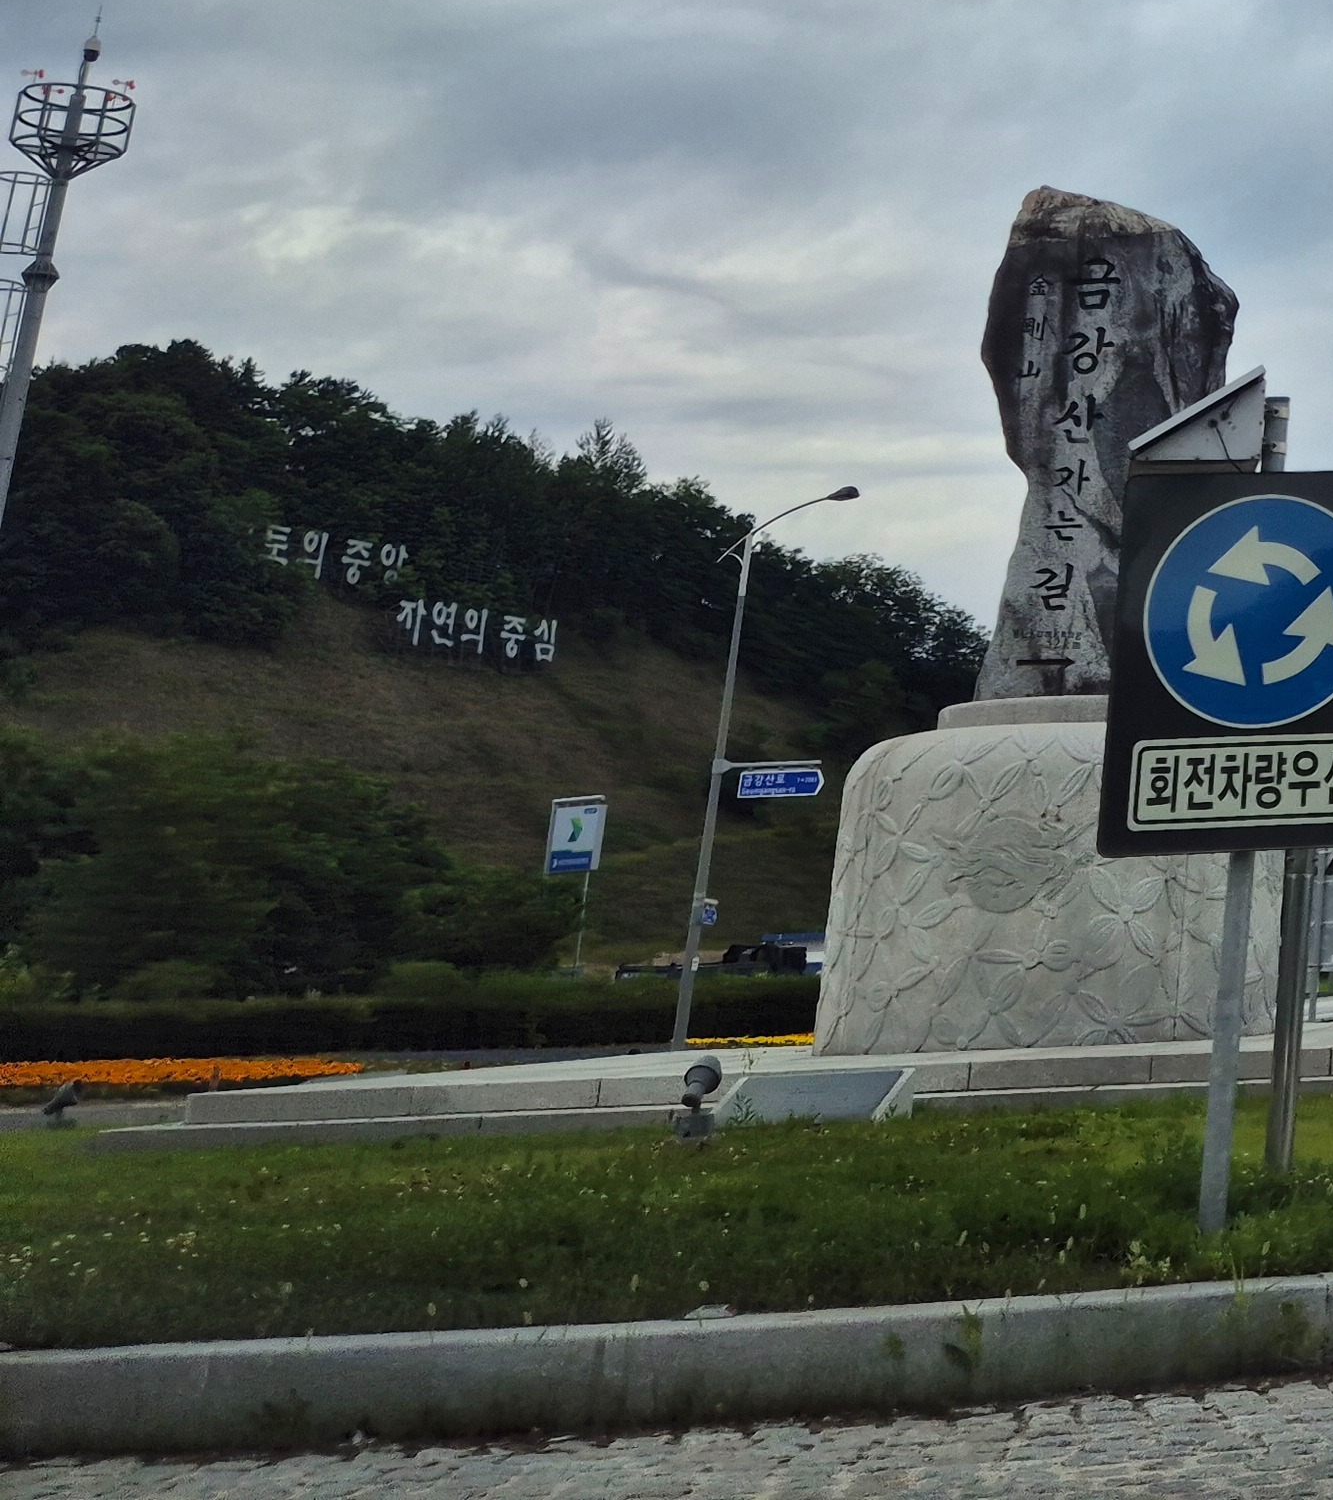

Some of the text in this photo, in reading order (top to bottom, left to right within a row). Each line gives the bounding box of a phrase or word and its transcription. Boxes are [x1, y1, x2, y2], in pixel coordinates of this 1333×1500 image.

[248, 523, 409, 586] 토의 중앙
[396, 598, 558, 663] 자연의 중심
[743, 773, 786, 788] 금강산로
